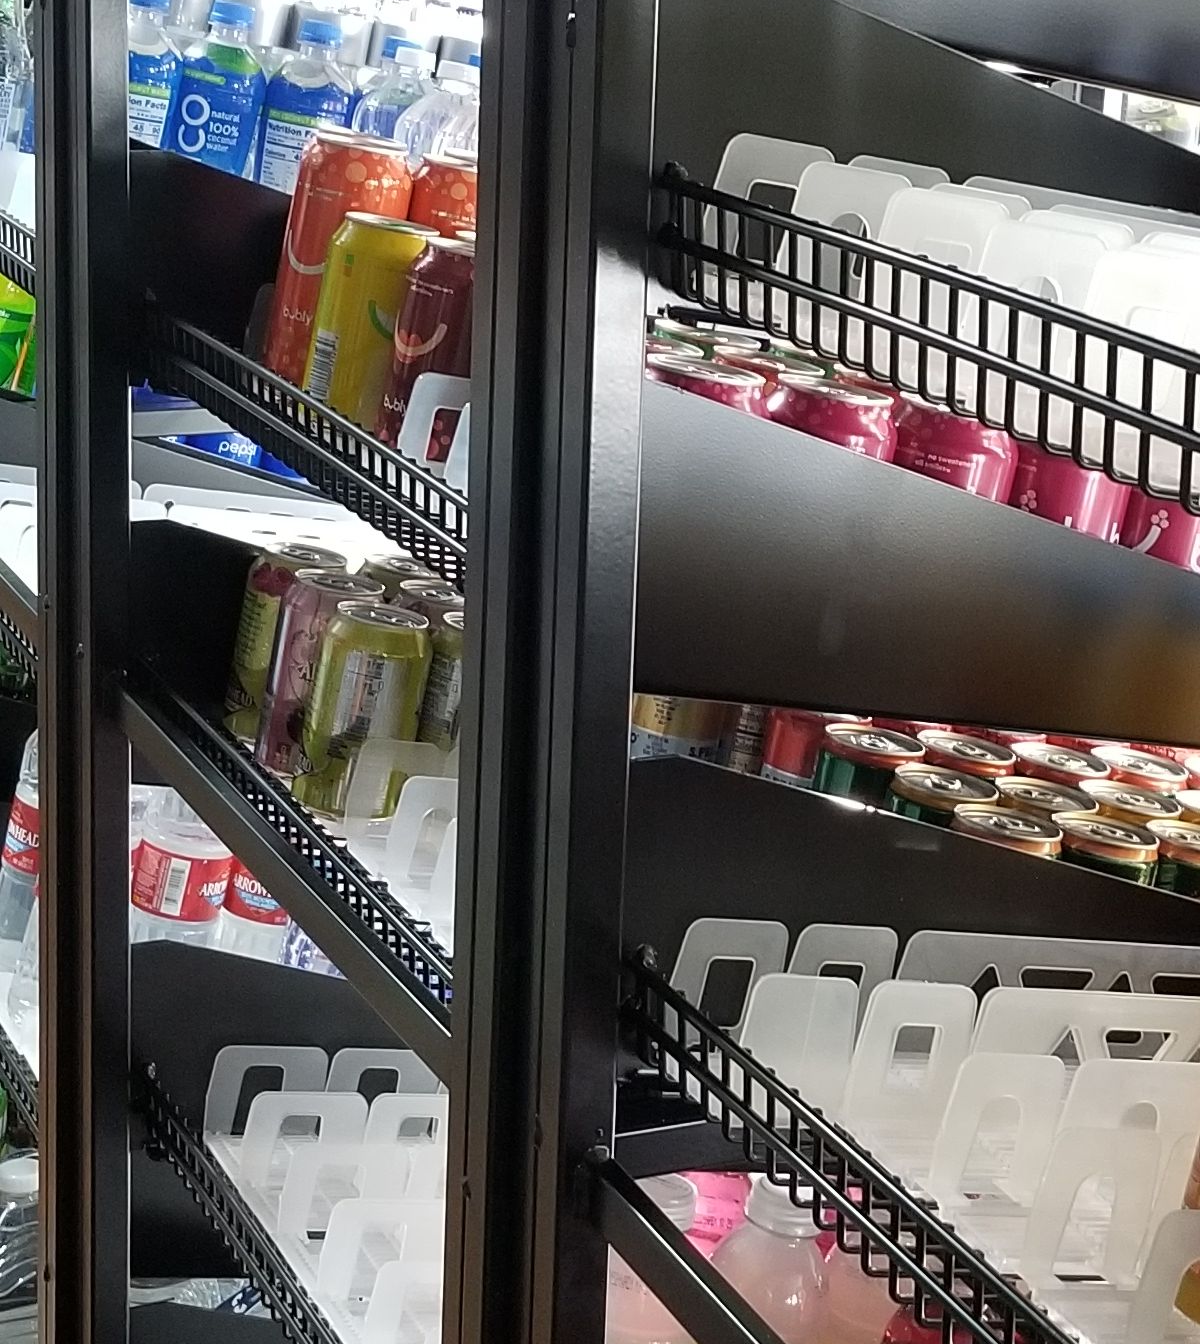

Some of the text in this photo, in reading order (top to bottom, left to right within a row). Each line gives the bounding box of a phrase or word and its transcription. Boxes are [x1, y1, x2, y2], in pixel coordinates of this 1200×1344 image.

[211, 109, 241, 123] natural
[208, 121, 240, 138] 100%
[282, 305, 313, 327] bubly
[218, 440, 257, 458] pepsi
